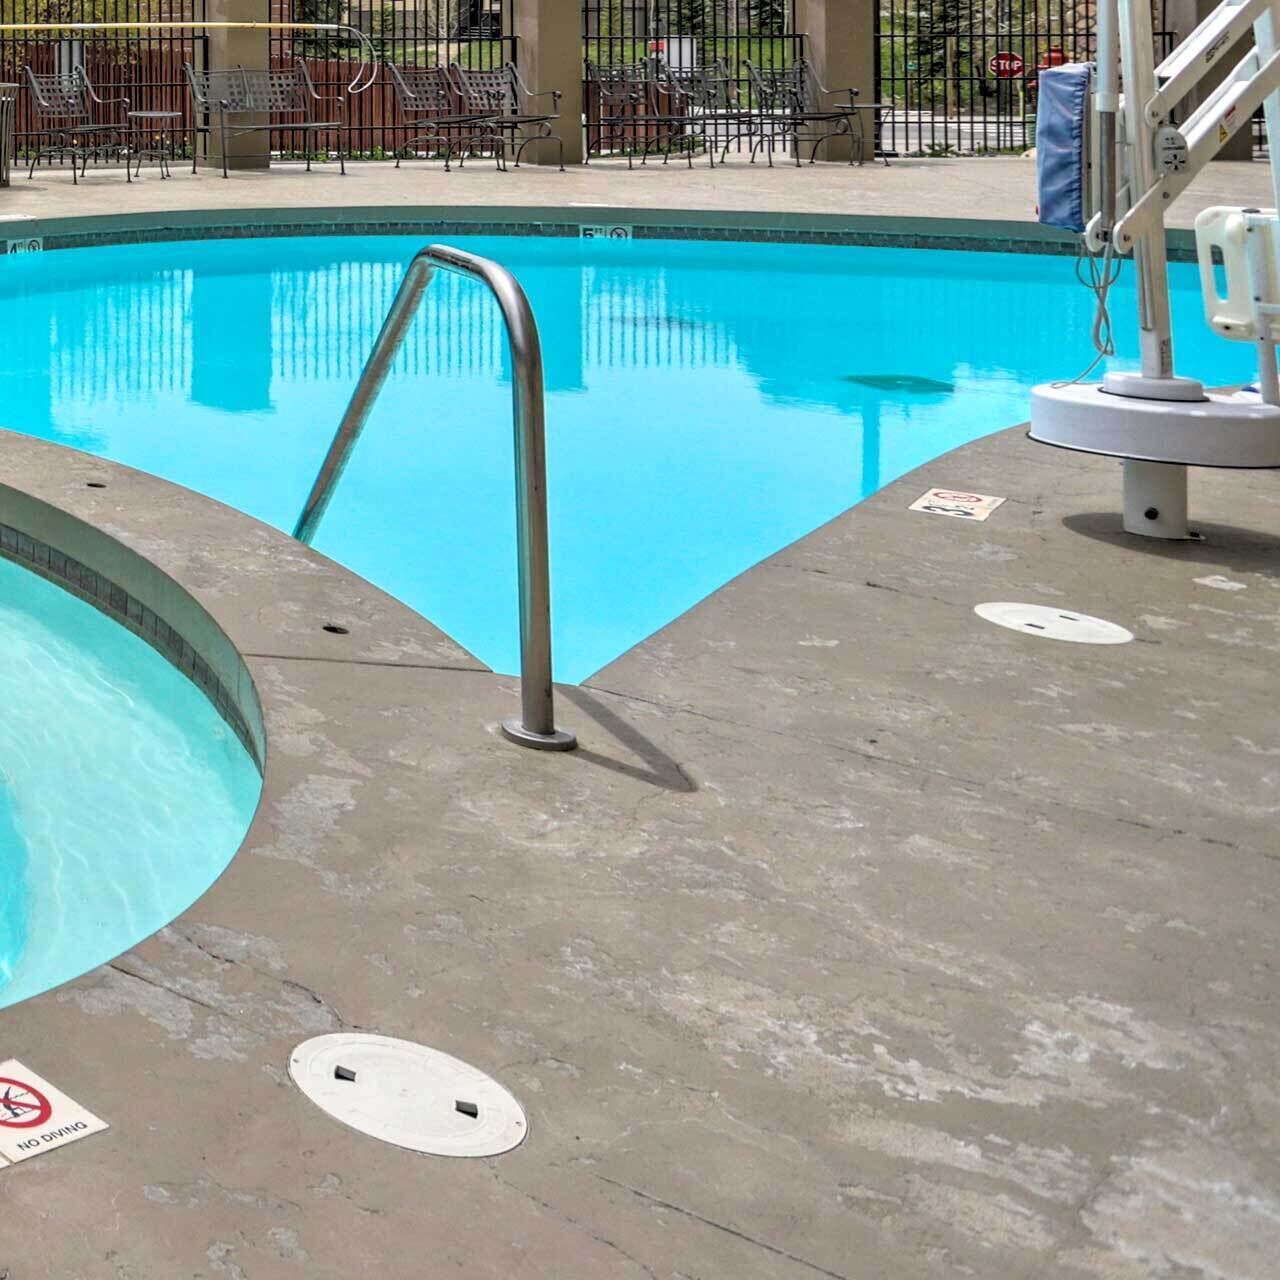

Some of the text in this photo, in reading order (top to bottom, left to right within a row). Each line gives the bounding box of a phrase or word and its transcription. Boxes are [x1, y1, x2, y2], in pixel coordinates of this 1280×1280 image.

[991, 60, 1022, 71] STOP
[16, 1120, 89, 1152] NO DIVING
